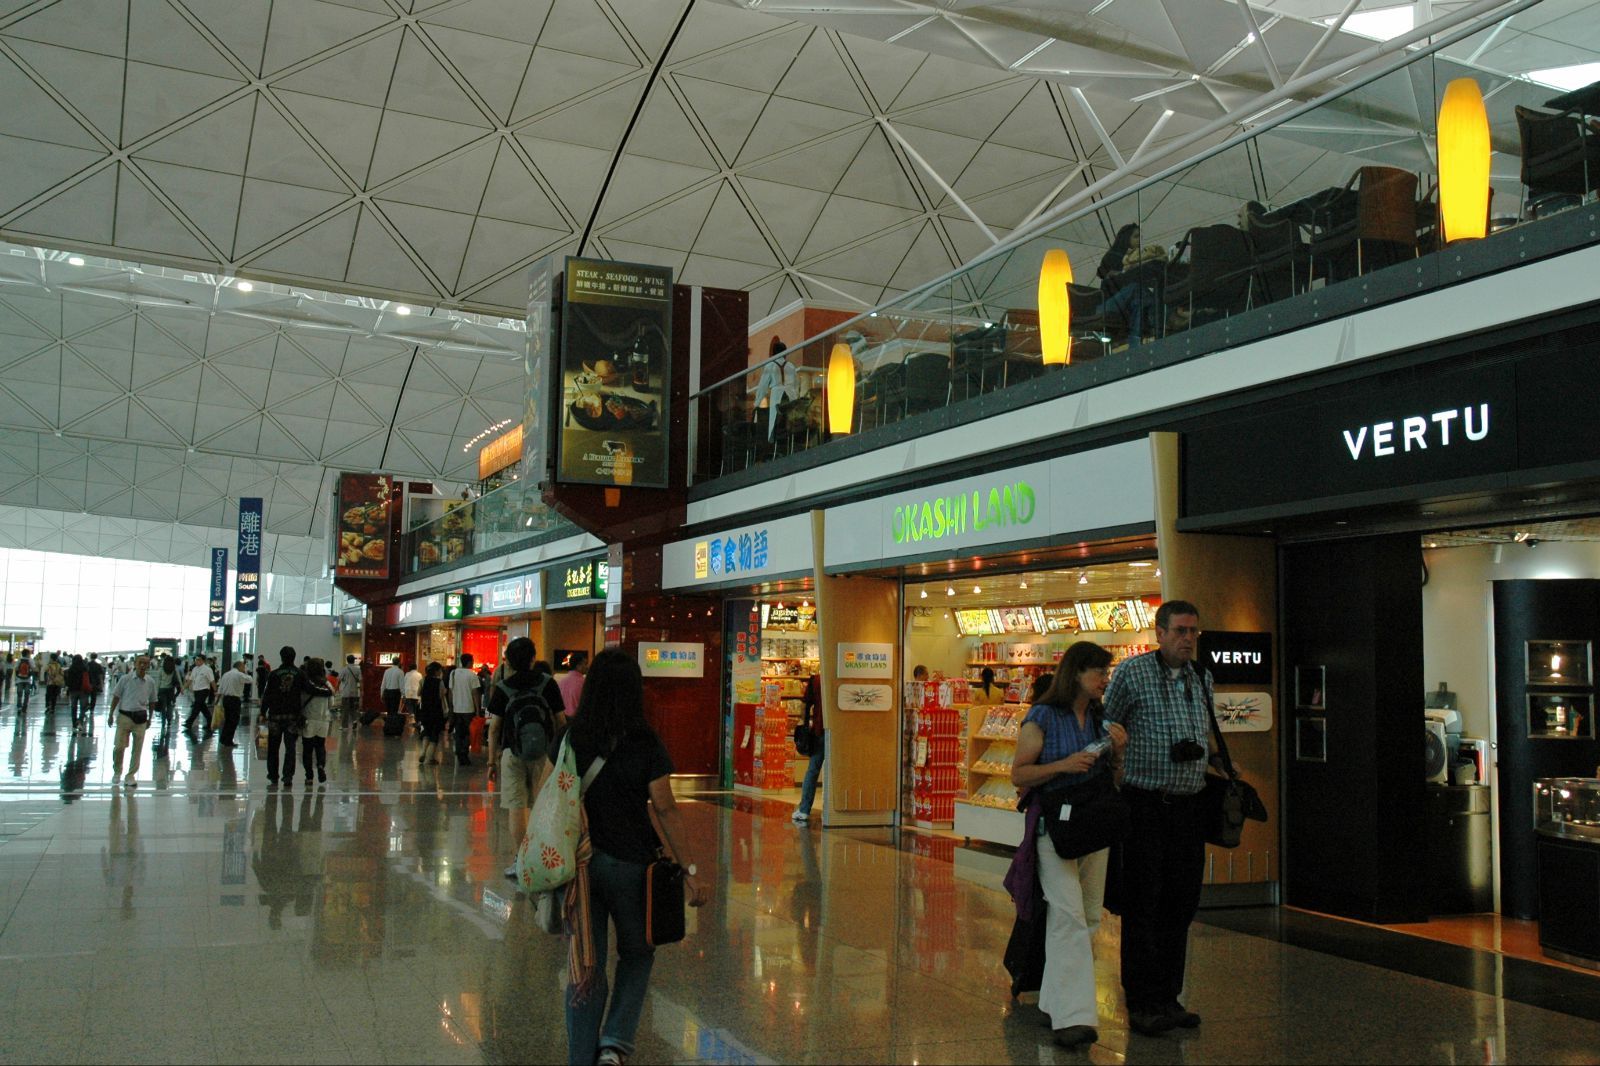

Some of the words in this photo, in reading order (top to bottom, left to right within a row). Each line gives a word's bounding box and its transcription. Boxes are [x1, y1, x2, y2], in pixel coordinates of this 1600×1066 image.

[577, 270, 598, 279] STEAK
[606, 273, 638, 283] SEAFOOD
[645, 277, 664, 286] WINE
[1343, 403, 1489, 460] VERTU
[240, 511, 260, 556] 離港
[892, 493, 967, 544] OKASHI
[972, 480, 1036, 532] LAND
[215, 549, 225, 597] Departures
[710, 529, 768, 576] 零食物語
[238, 582, 257, 590] South
[1211, 651, 1262, 664] VERTU
